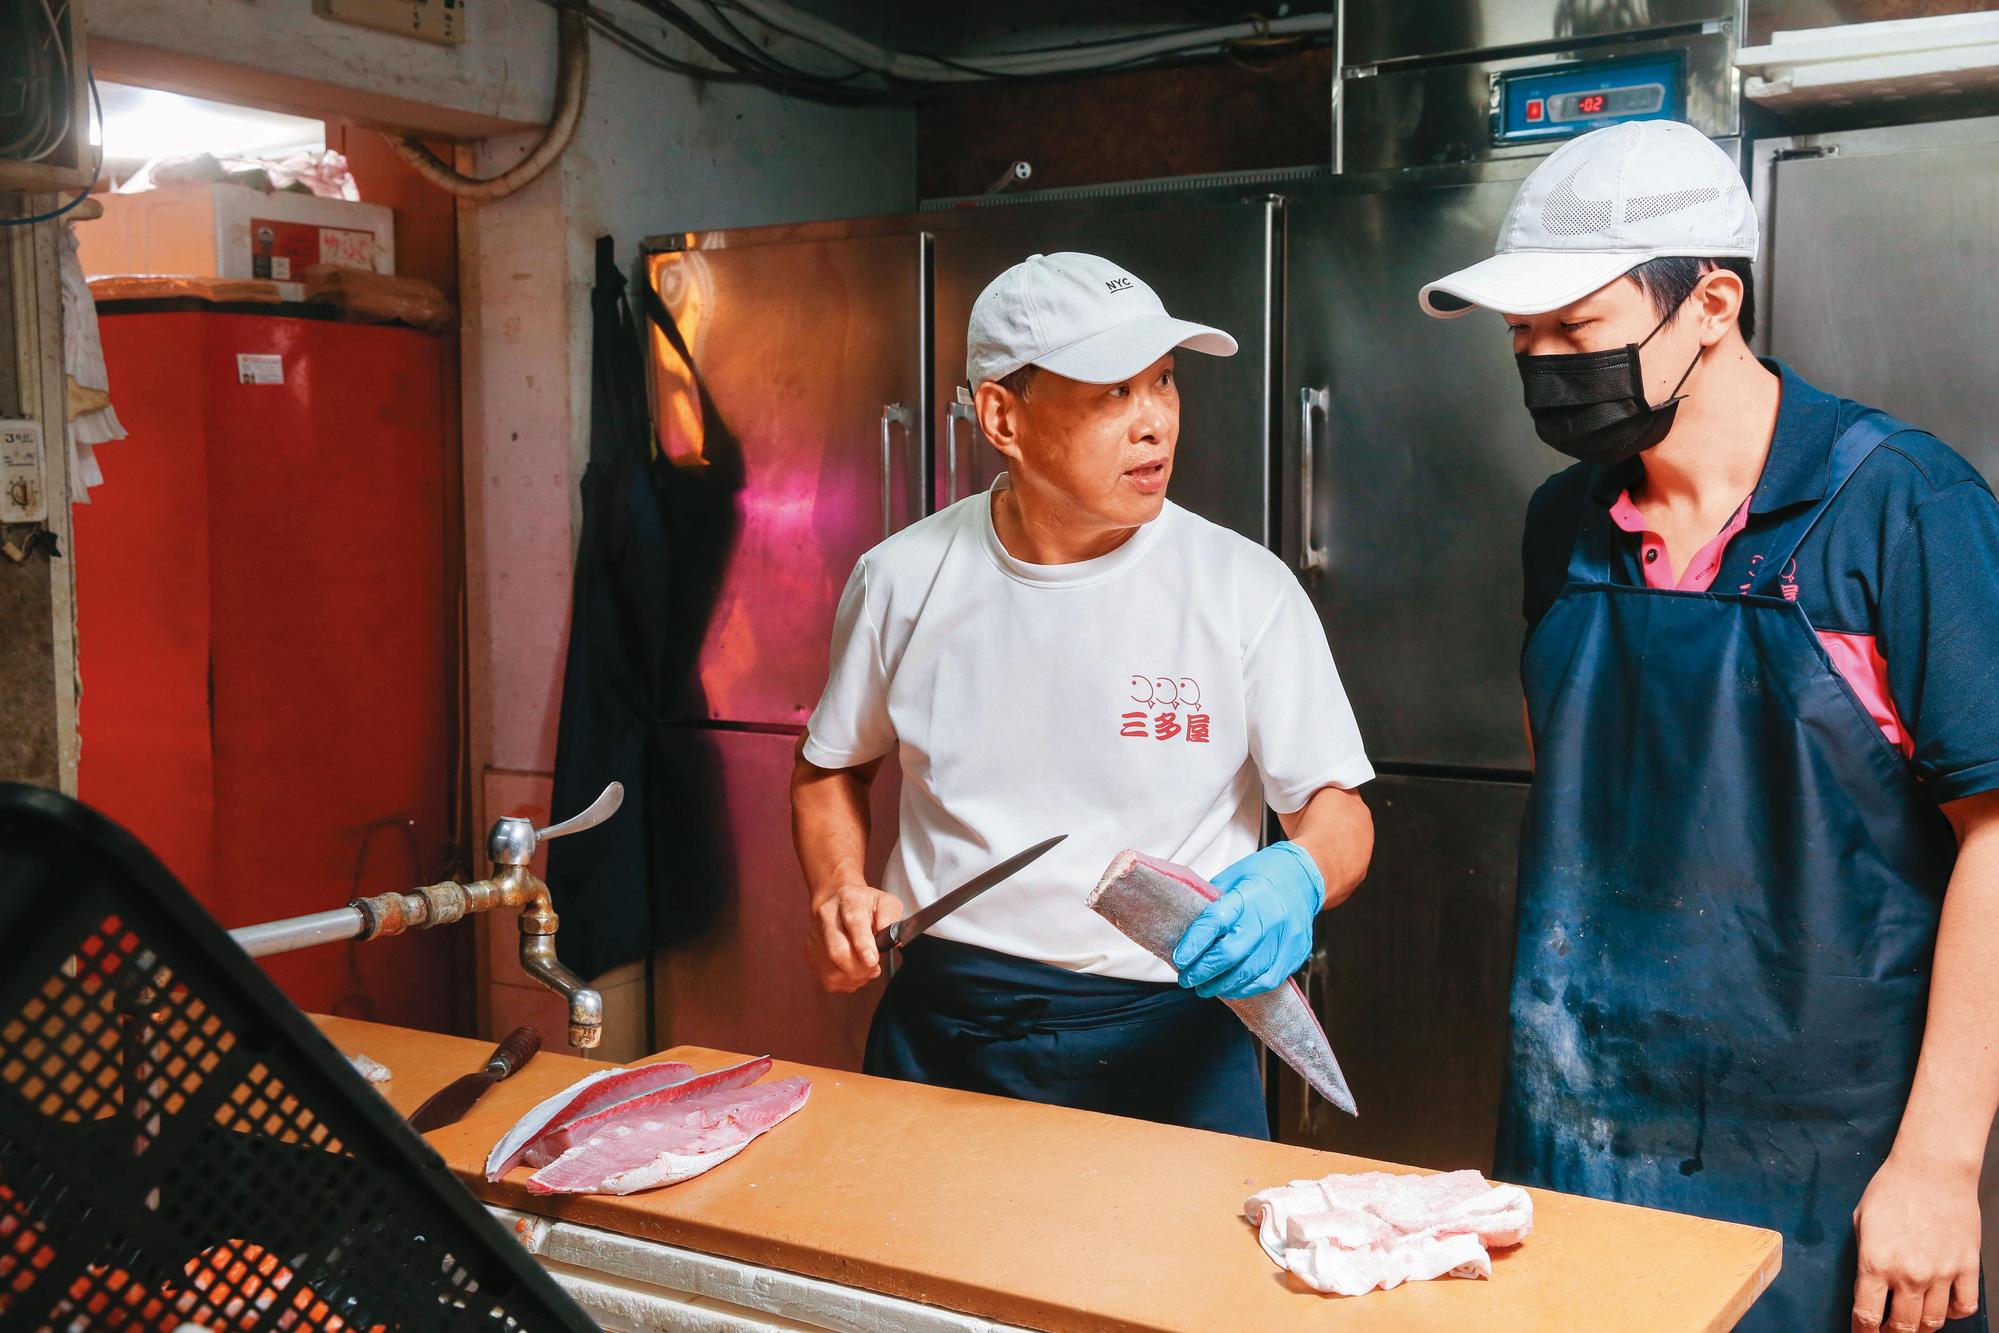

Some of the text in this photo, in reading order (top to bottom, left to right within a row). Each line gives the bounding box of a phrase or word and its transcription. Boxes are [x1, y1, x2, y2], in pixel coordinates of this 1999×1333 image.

[1105, 277, 1131, 290] NYC
[1119, 711, 1211, 744] 三多屋
